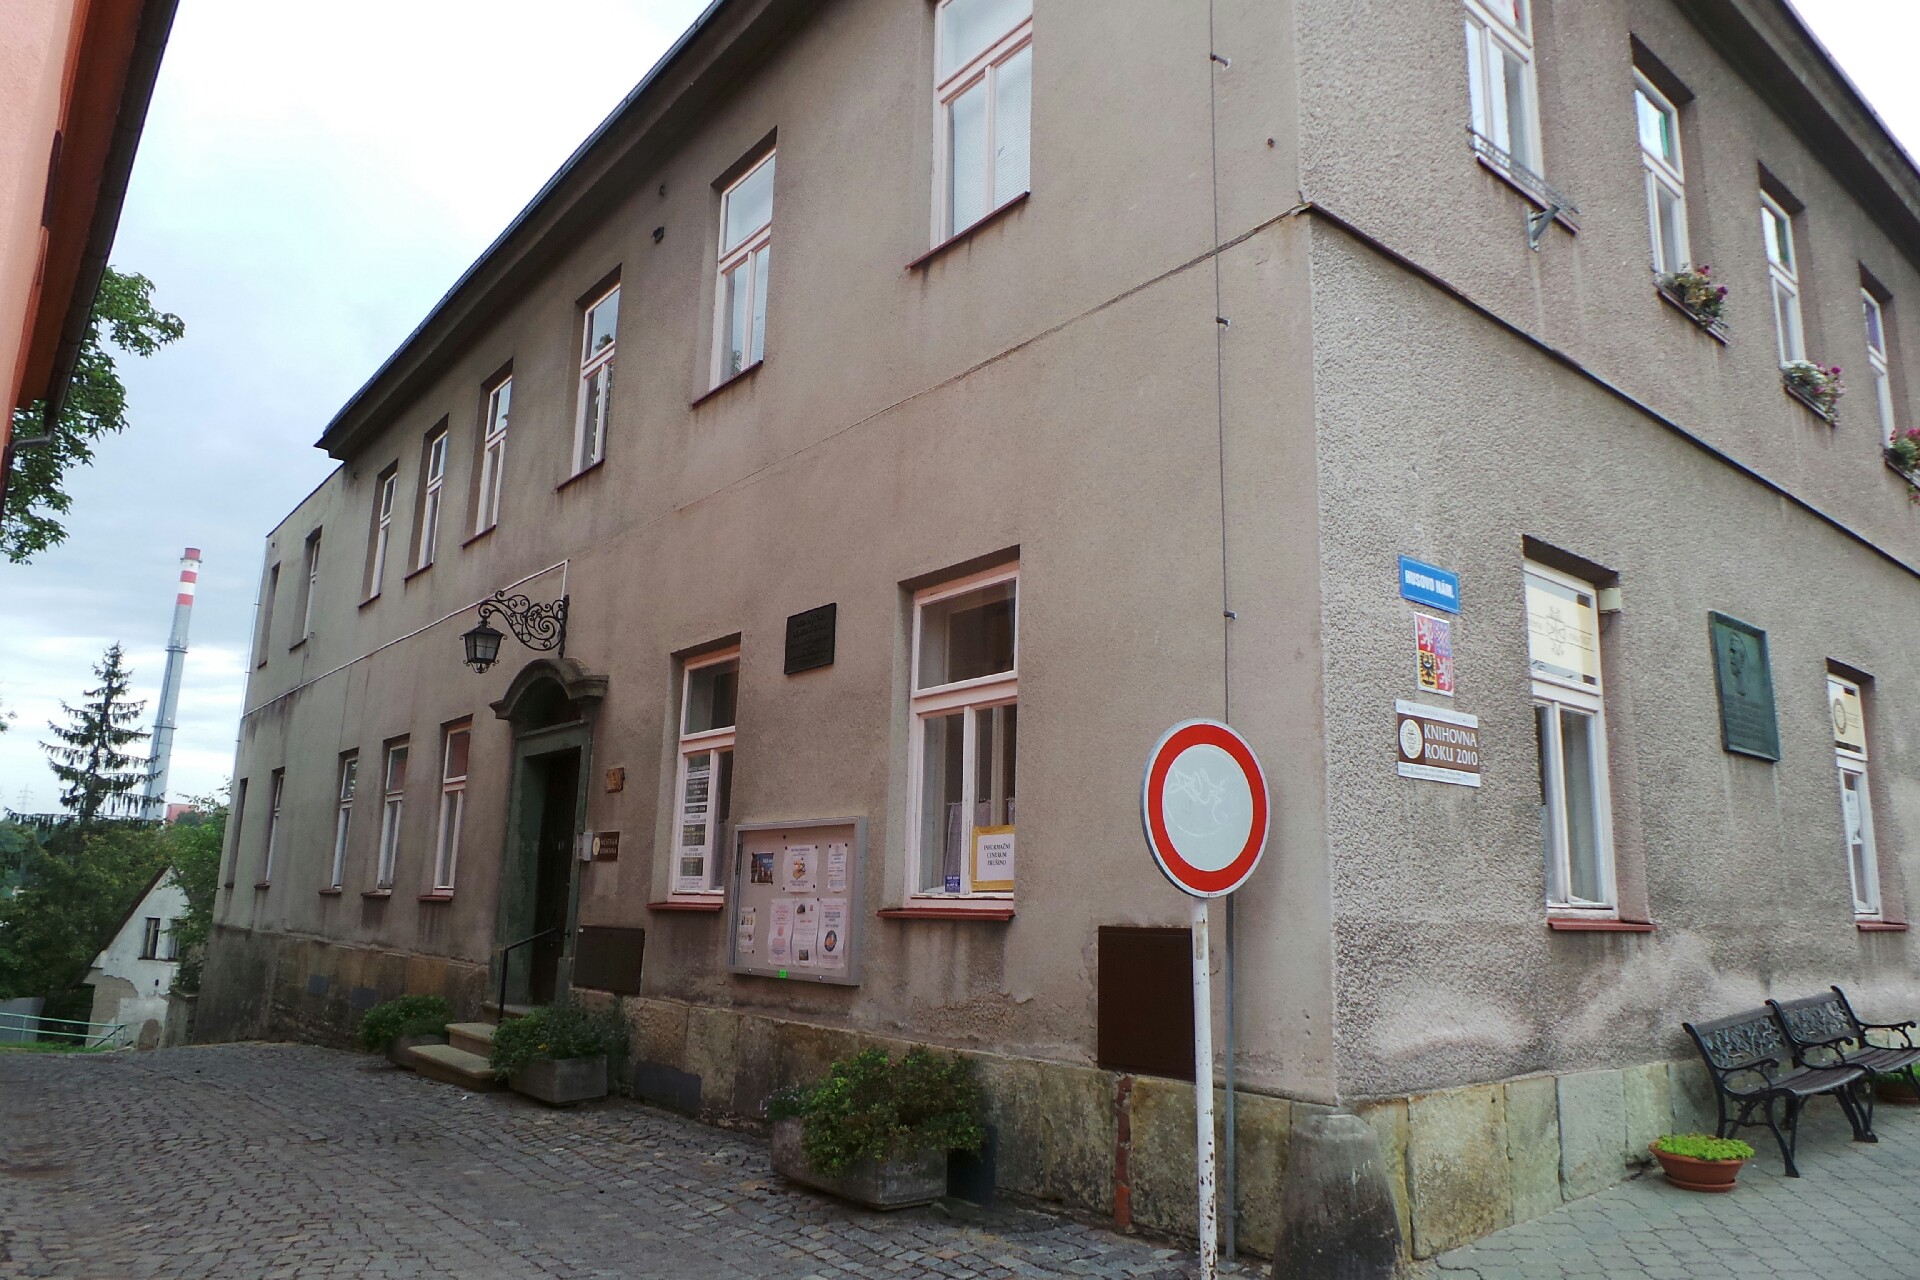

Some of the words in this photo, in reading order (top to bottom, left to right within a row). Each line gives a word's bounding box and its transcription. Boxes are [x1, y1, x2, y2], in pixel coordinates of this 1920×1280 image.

[1404, 569, 1435, 592] HUSOVO
[1423, 723, 1478, 748] KNIHOVNA
[1424, 743, 1454, 762] ROKU
[1456, 748, 1478, 766] 2010
